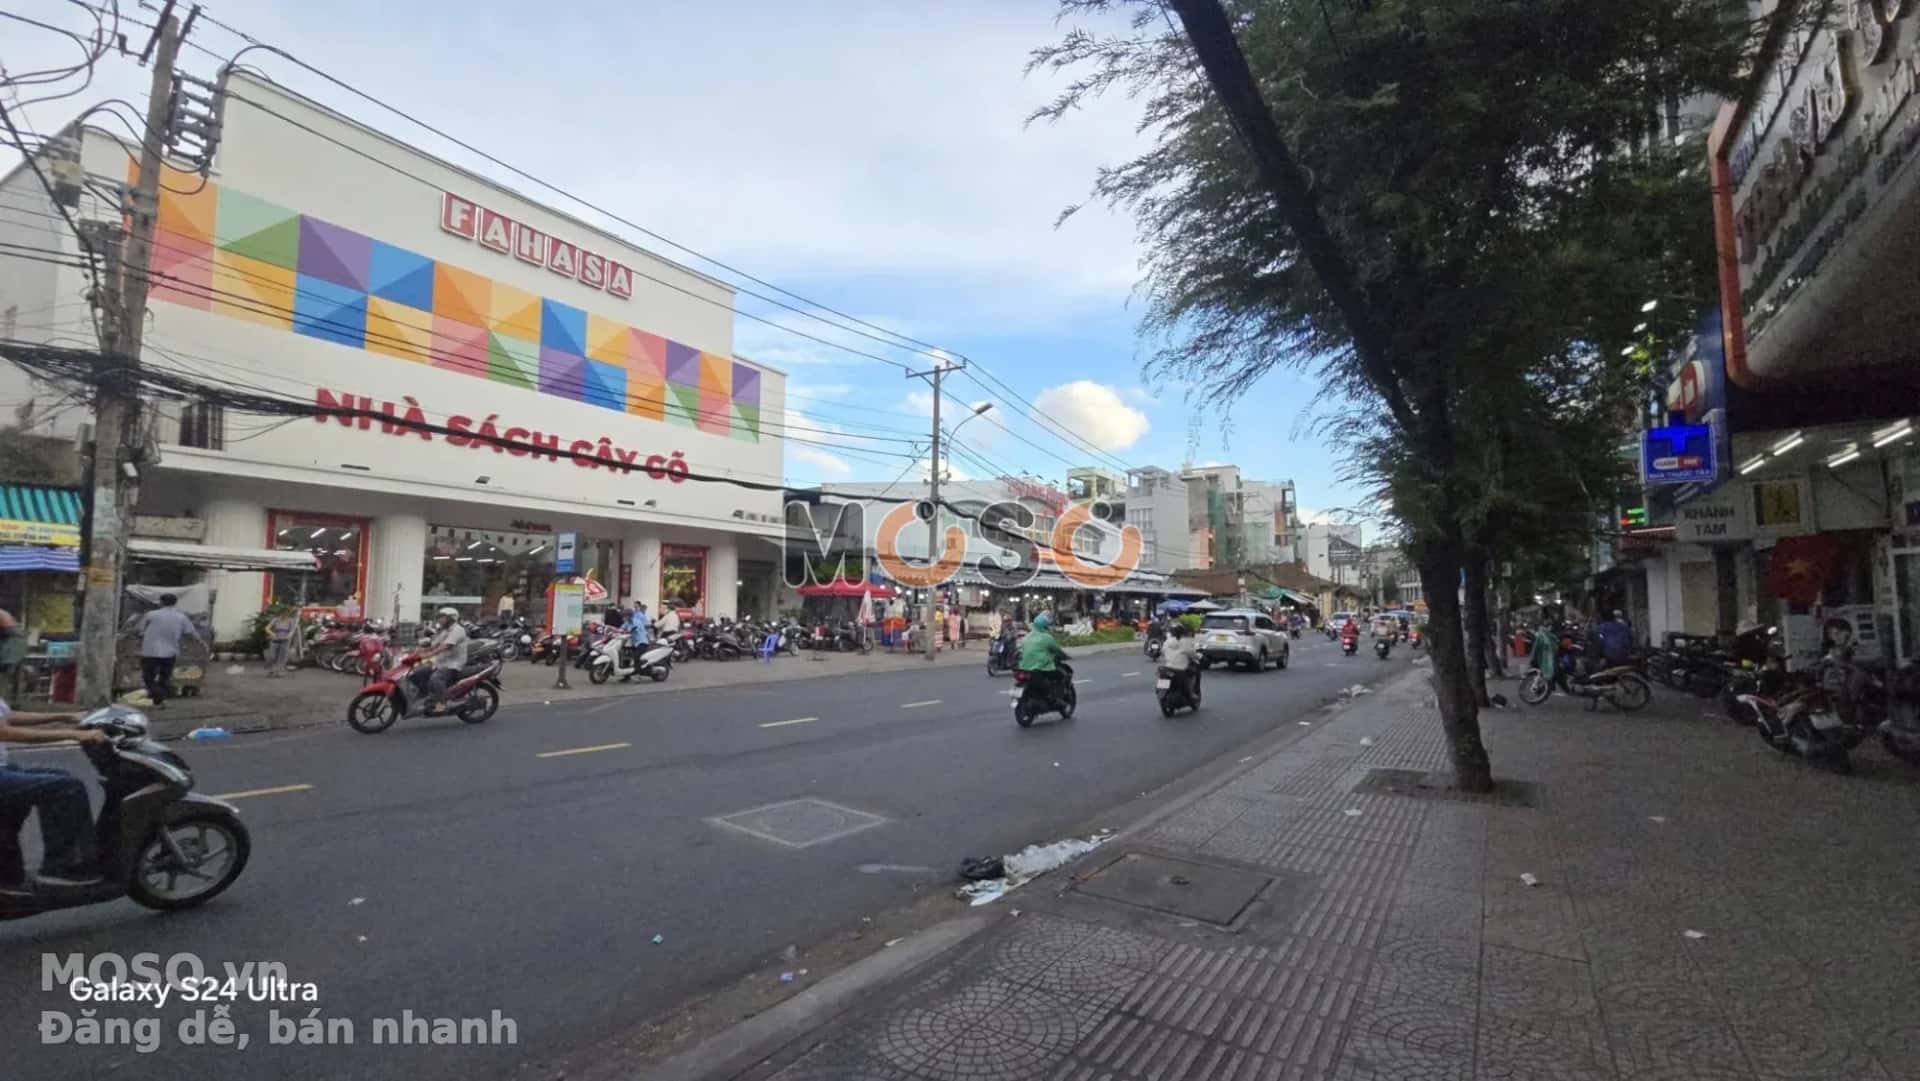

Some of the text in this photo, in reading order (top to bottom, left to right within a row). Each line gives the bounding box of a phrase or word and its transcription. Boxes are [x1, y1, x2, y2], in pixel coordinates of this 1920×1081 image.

[444, 193, 633, 297] FAHASA
[314, 388, 431, 441] NHÀ
[445, 414, 559, 462] SÁCH
[570, 437, 638, 474] CÂY
